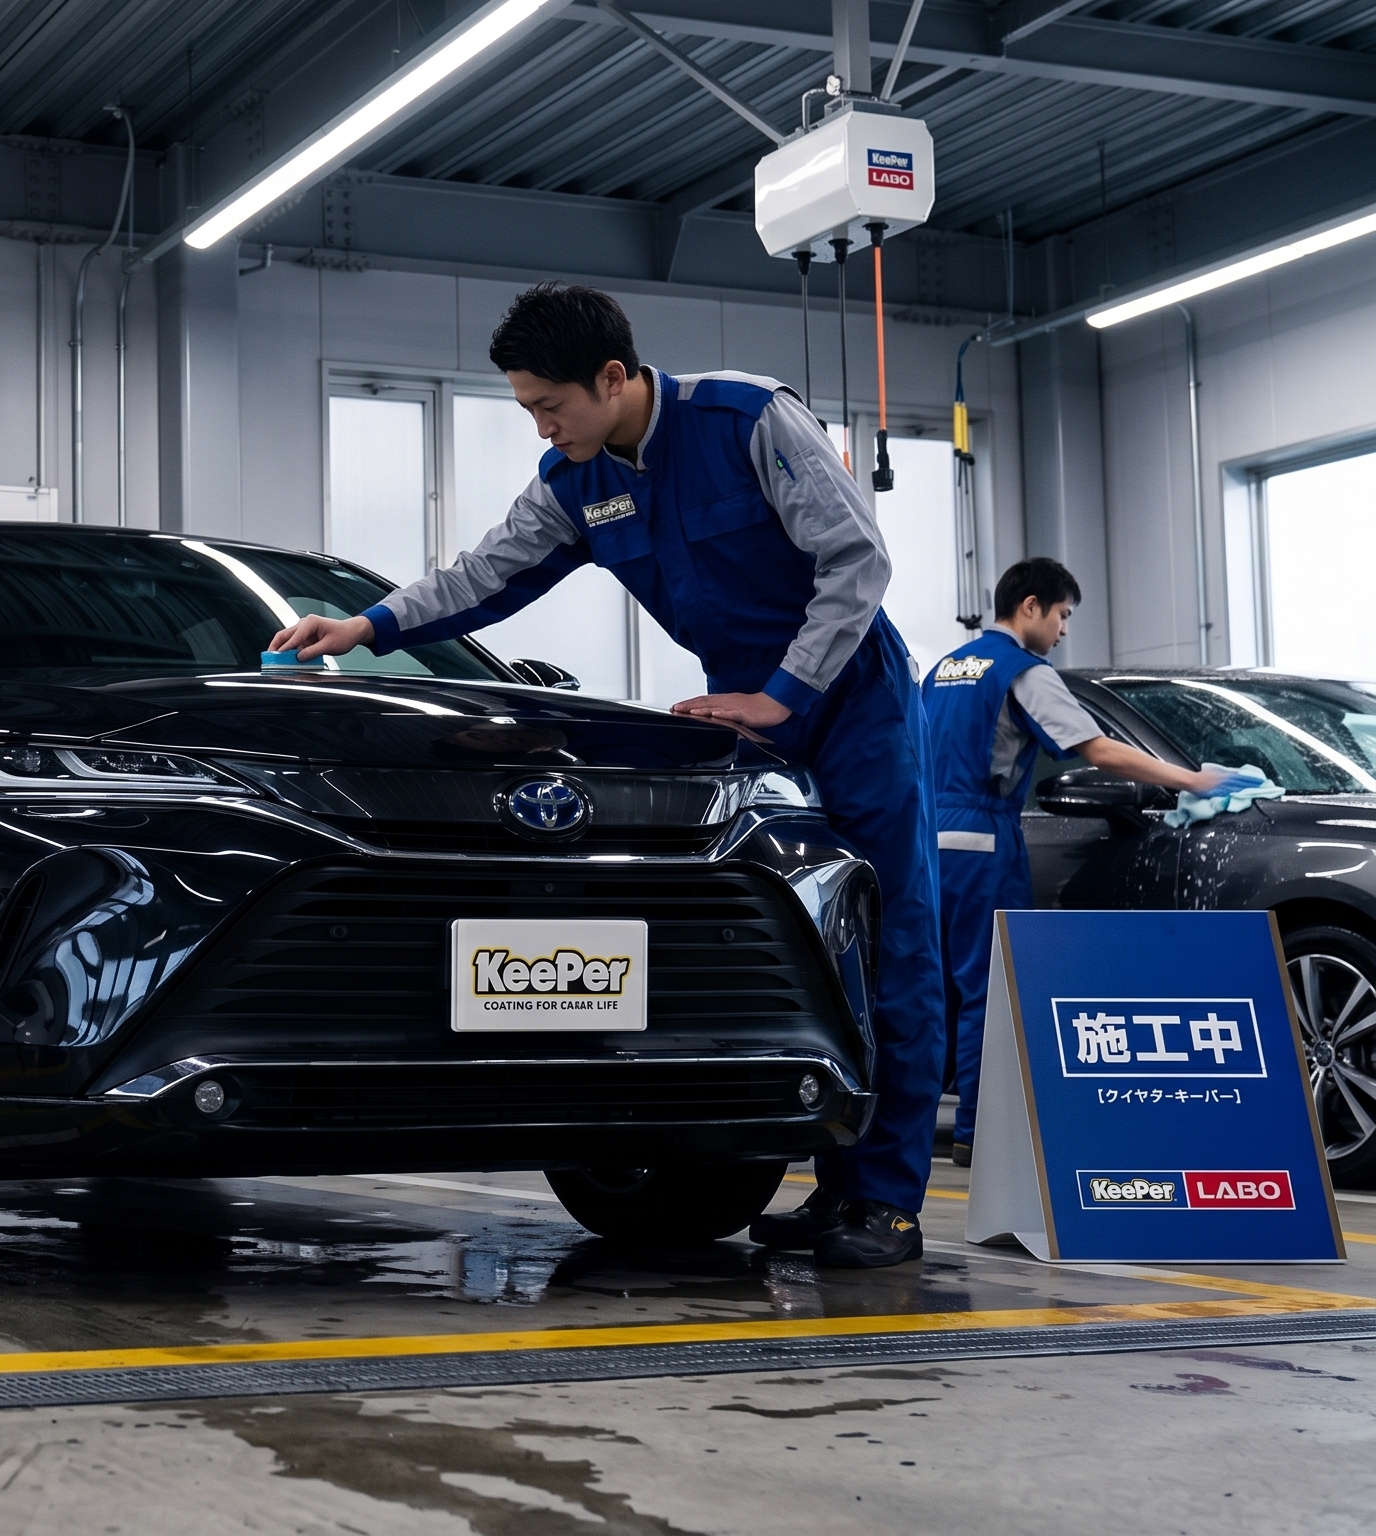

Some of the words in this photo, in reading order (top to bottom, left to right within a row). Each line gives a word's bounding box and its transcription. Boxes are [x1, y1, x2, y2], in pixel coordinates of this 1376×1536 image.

[873, 172, 910, 185] LABO
[474, 949, 630, 994] KeePer
[484, 1001, 533, 1010] COATING
[536, 1001, 558, 1010] FOR
[597, 1001, 618, 1010] LIFE
[1072, 1012, 1242, 1064] 施工中
[1091, 1180, 1174, 1201] KeePer
[1197, 1181, 1281, 1200] LABO
